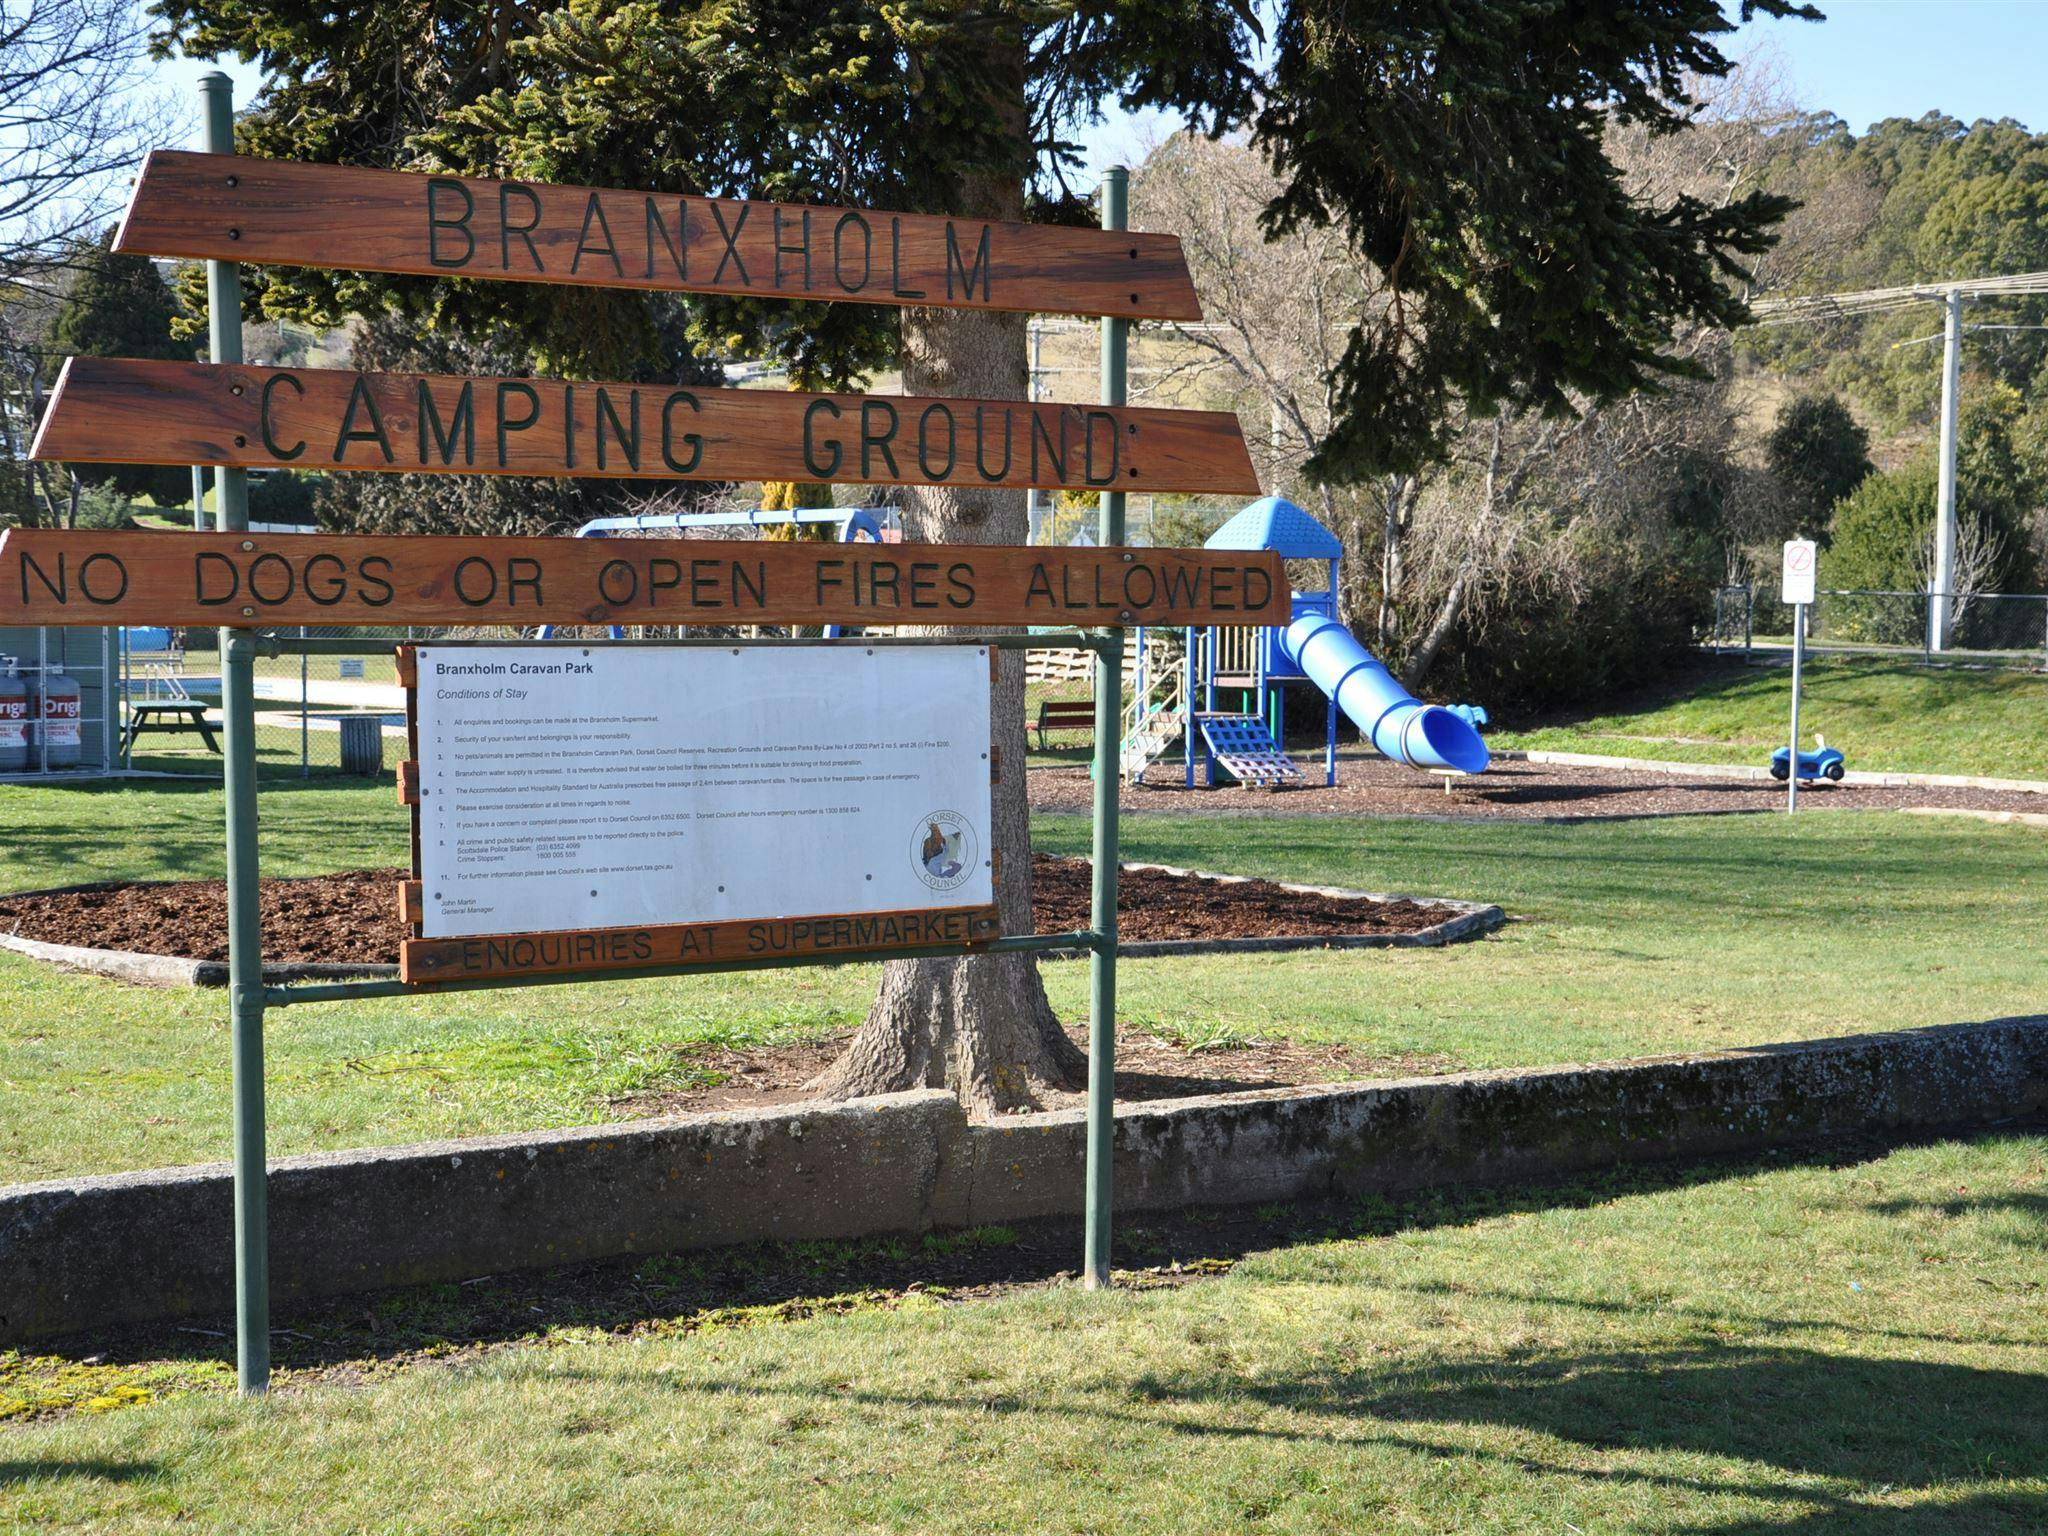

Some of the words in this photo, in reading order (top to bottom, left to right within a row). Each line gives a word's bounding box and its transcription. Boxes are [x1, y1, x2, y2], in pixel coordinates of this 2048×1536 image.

[427, 178, 991, 301] BRANXHOLM
[262, 373, 702, 473] CAMPING
[803, 398, 1119, 485] GROUND
[19, 550, 128, 605] NO
[195, 551, 395, 606] DOGS
[454, 556, 544, 607] OR
[599, 558, 766, 608] OPEN
[816, 560, 976, 609] FIRES
[1025, 562, 1272, 610] ALLOWED
[436, 663, 506, 675] Branxholm
[510, 663, 561, 674] Caravan
[565, 662, 593, 674] Park
[436, 689, 490, 700] Conditions
[492, 688, 504, 699] of
[505, 688, 528, 700] Stay
[926, 812, 963, 826] DORSET
[923, 873, 966, 888] COUNCIL
[467, 906, 494, 915] Manager
[462, 931, 653, 970] ENQUIRIES
[680, 925, 718, 957] AT
[748, 910, 978, 952] SUPERMARKET
